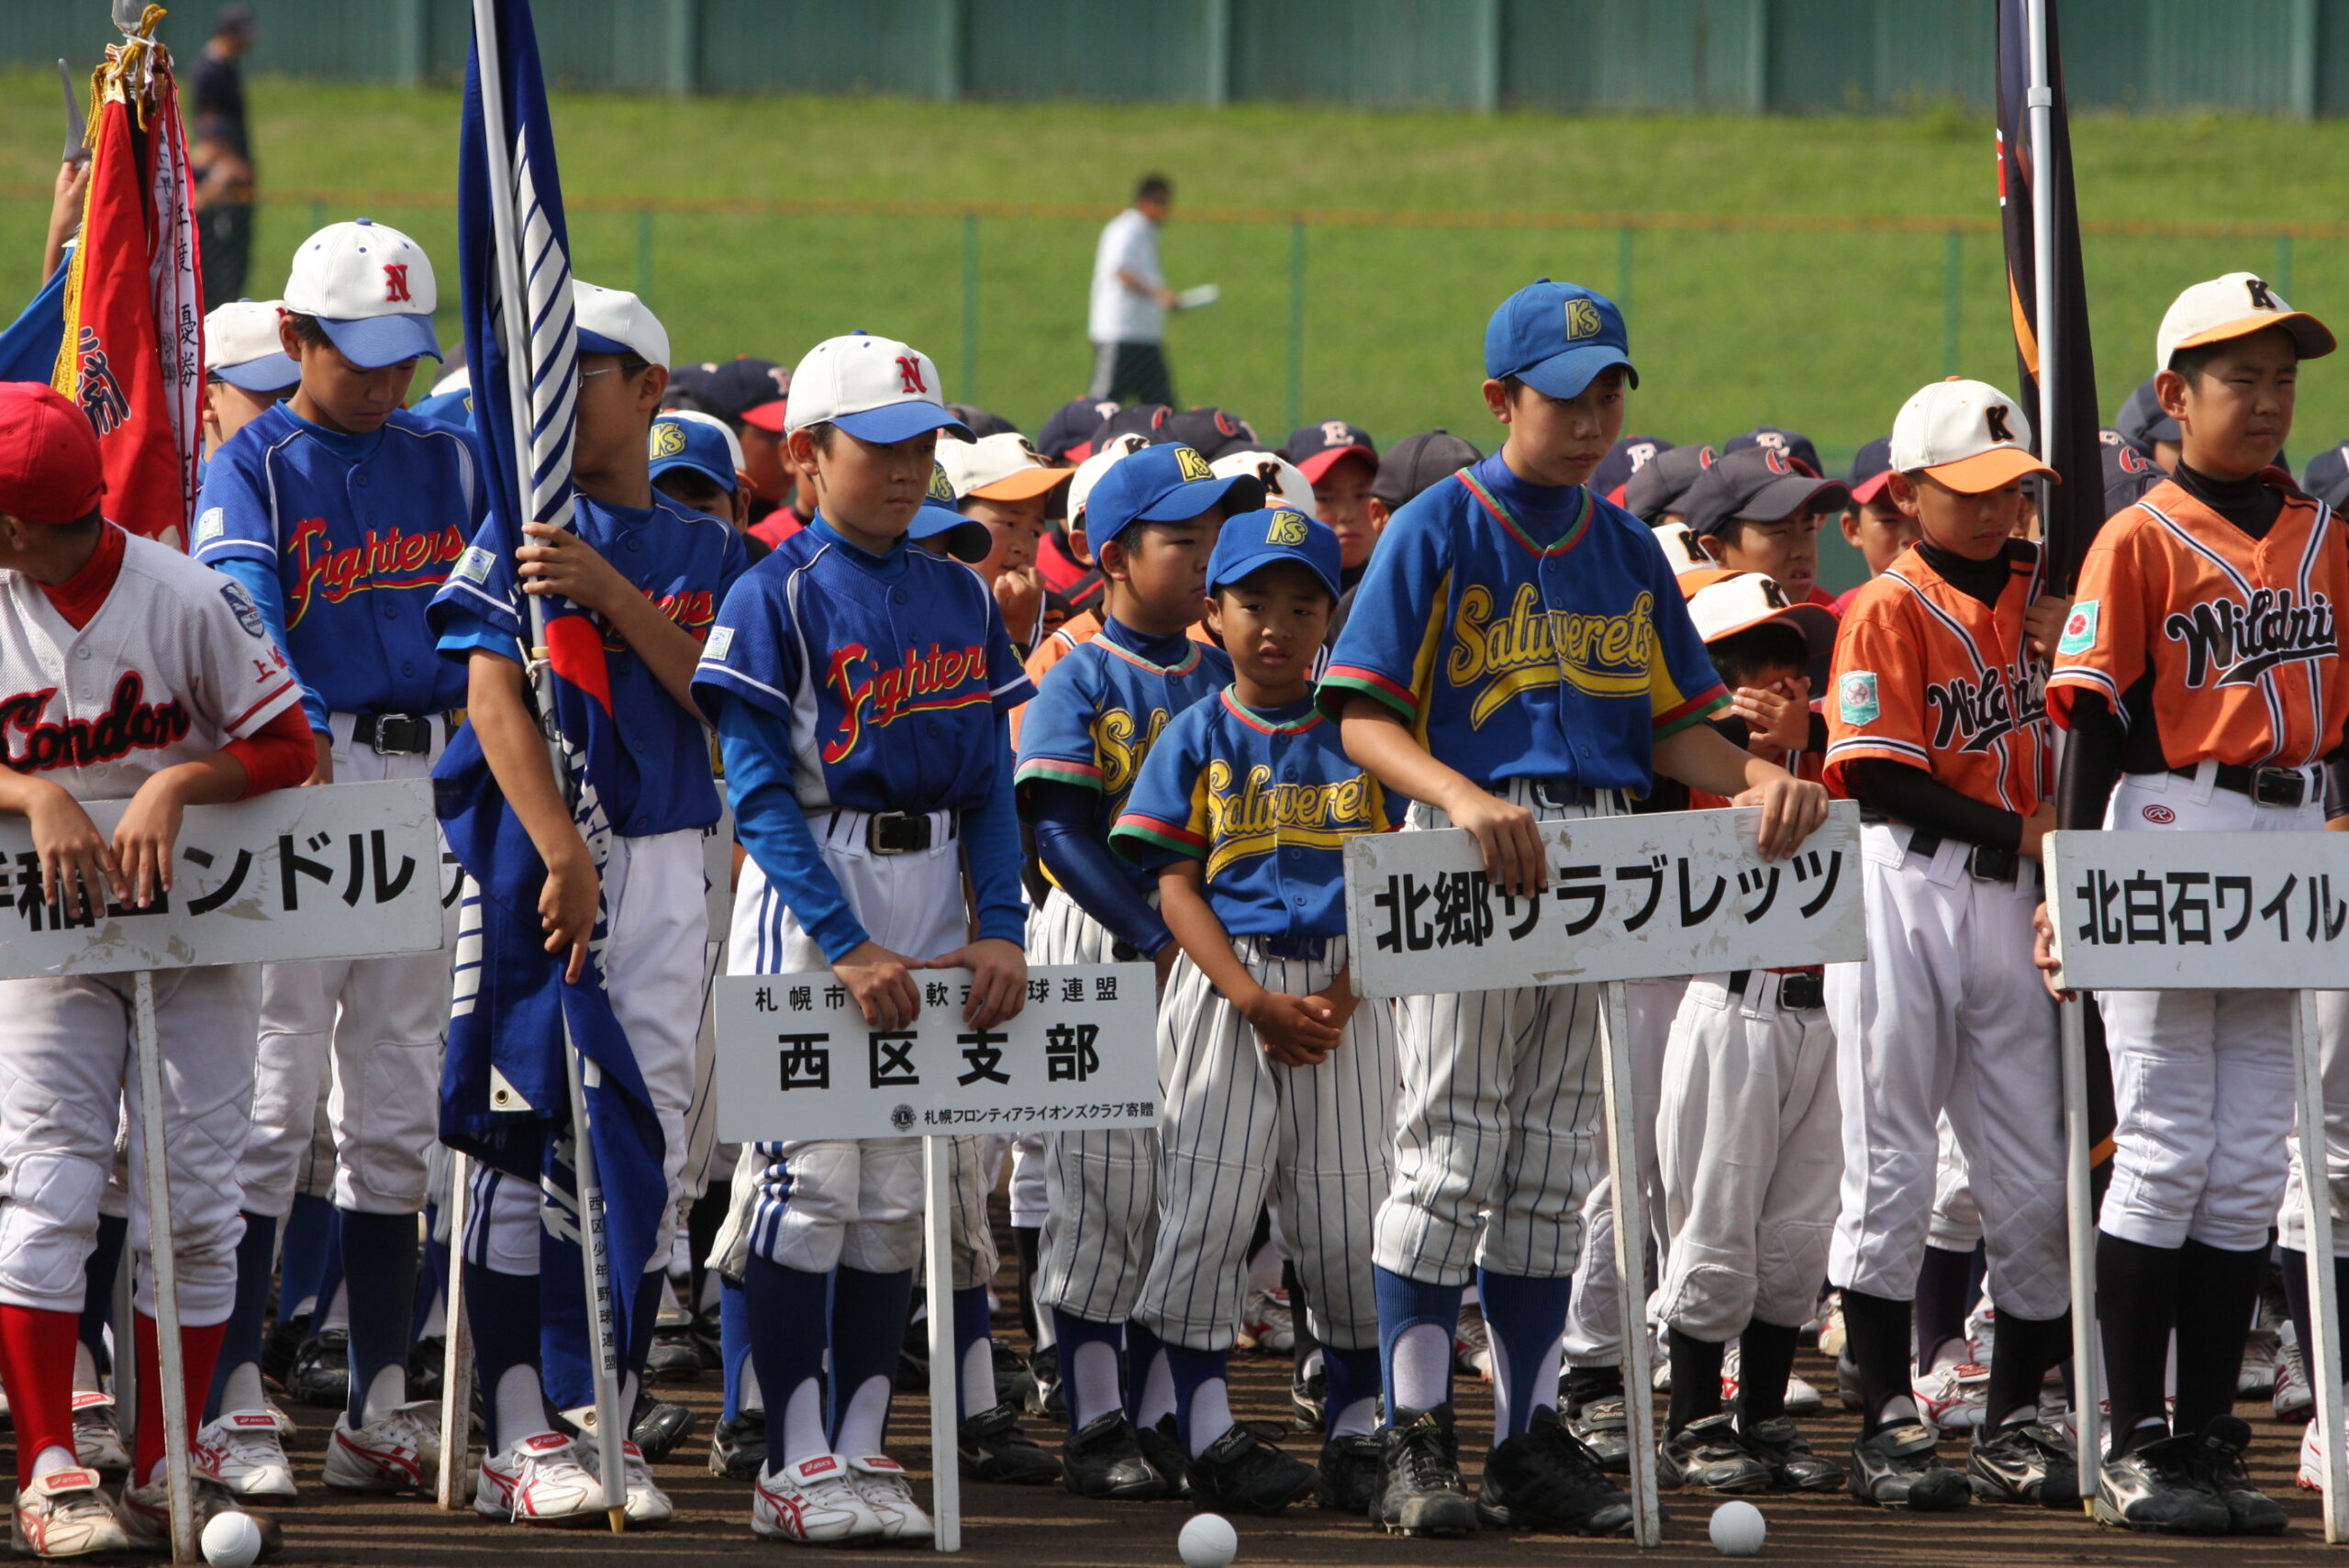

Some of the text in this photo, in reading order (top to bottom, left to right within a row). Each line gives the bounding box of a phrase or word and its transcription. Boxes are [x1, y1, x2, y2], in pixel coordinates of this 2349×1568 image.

[384, 264, 411, 302] N
[2245, 279, 2277, 310] K
[896, 356, 927, 394] N
[1986, 405, 2015, 442] K
[1257, 462, 1284, 496] K
[1678, 528, 1710, 562] K
[285, 517, 465, 631] Fighters
[1760, 579, 1788, 609] K
[2165, 587, 2337, 688] Wildni
[822, 642, 988, 764] Fighter
[1375, 850, 1842, 954] 北郷サラブレッツ
[2076, 869, 2347, 946] 北白石ワイル
[778, 1023, 1100, 1091] 西区支部
[924, 1102, 1154, 1125] 札幌フロンティアライオンズクラブ寄贈
[588, 1196, 617, 1371] 西区少年野球連盟
